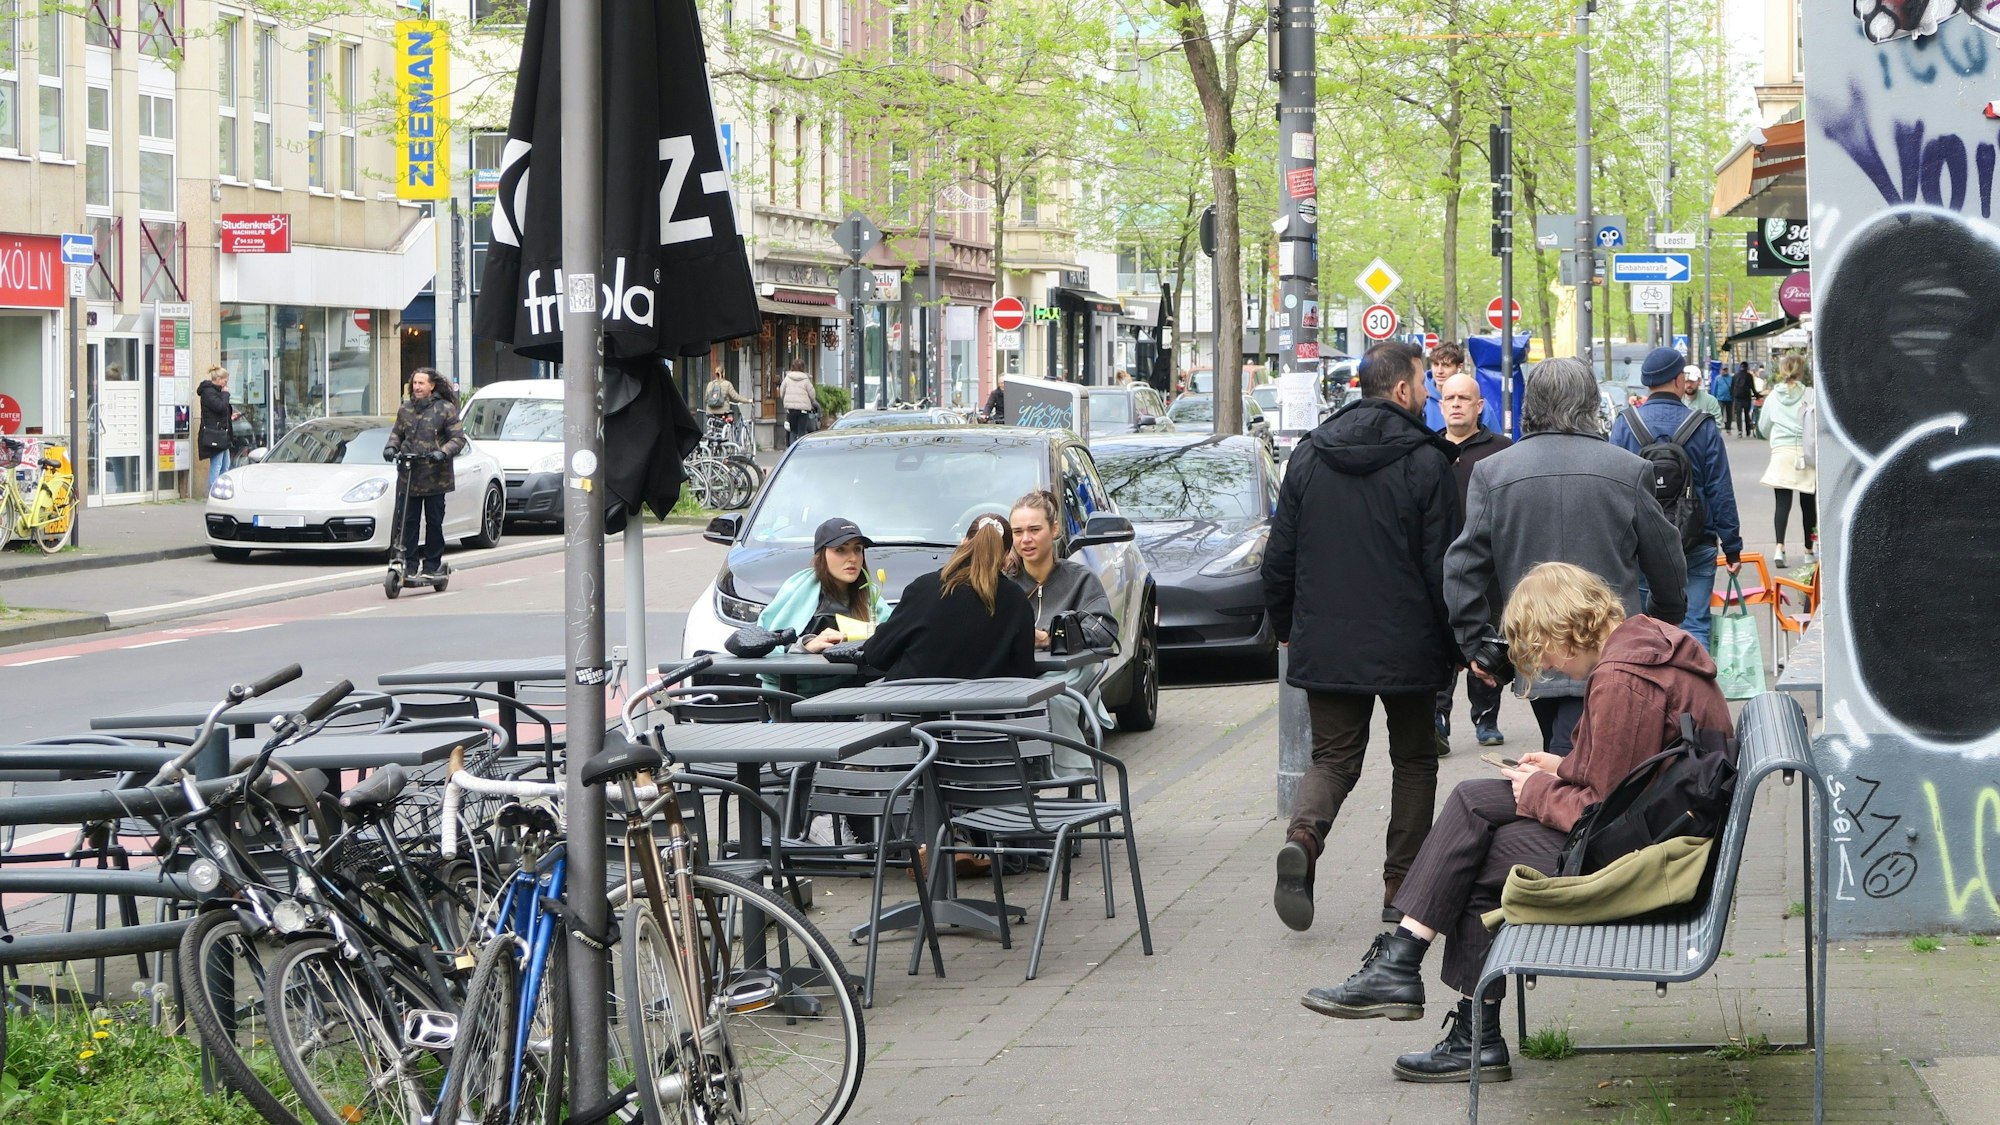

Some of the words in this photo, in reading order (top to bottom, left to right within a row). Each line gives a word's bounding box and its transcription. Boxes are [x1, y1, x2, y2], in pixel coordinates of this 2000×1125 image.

[408, 31, 434, 187] ZEEMAN
[222, 220, 276, 230] Studienkreis
[0, 241, 52, 291] KÖLN
[1618, 264, 1669, 272] Einbahnstraße
[1370, 314, 1389, 330] 30
[578, 669, 604, 683] MEHR
